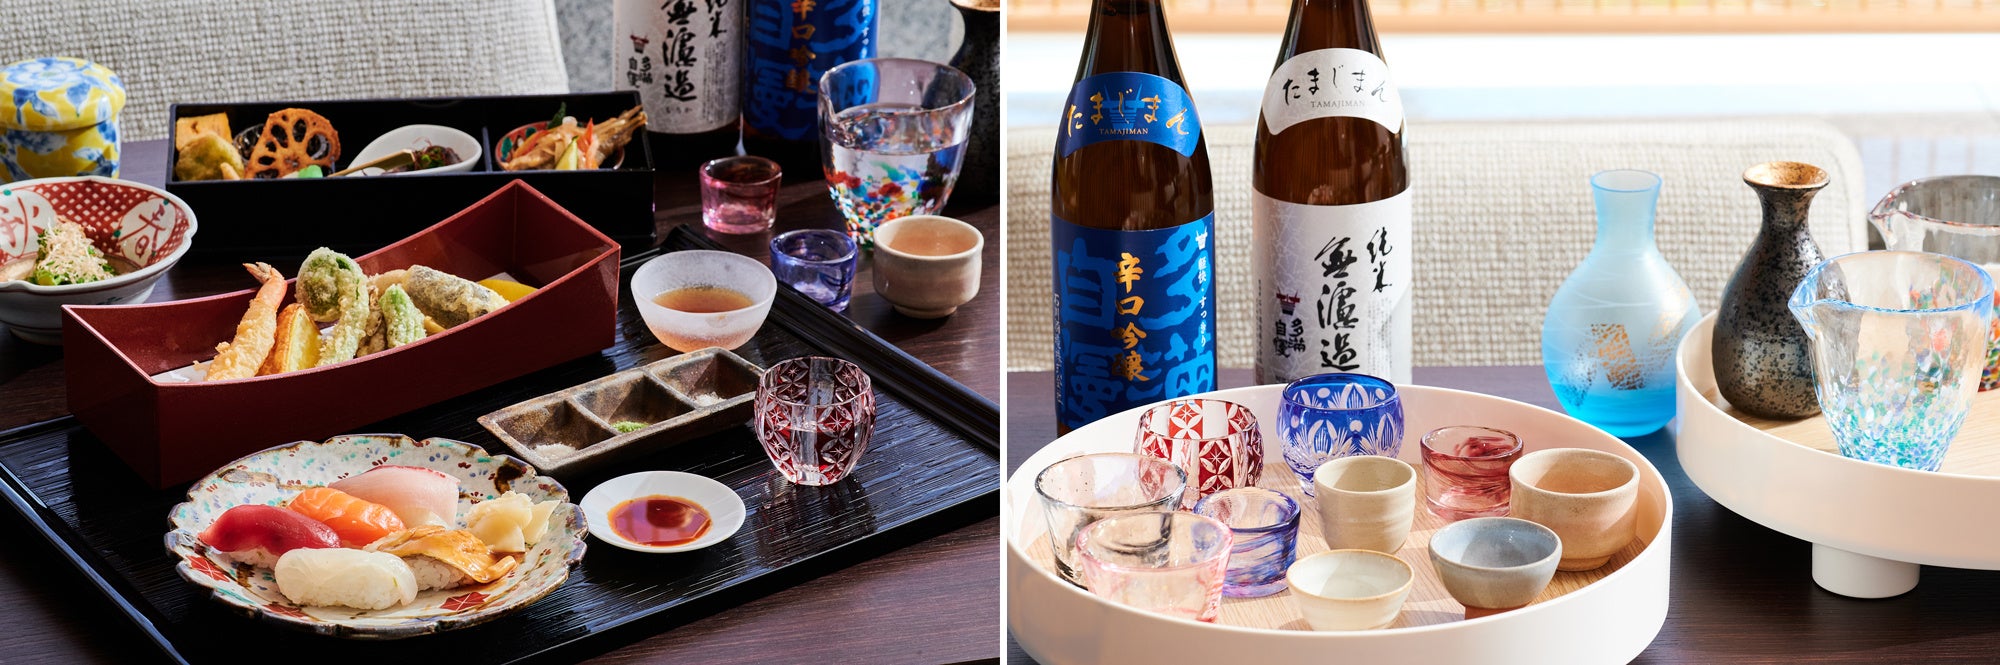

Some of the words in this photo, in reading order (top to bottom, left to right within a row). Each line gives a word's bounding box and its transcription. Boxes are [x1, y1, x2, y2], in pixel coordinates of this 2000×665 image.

[1283, 65, 1389, 106] たまじまん
[1310, 100, 1367, 109] TAMAJIMAN
[1065, 88, 1191, 138] たまじまん
[1099, 127, 1150, 136] TAMAJIMAN
[1110, 252, 1151, 383] 辛口吟醸
[1314, 236, 1361, 372] 無濾過
